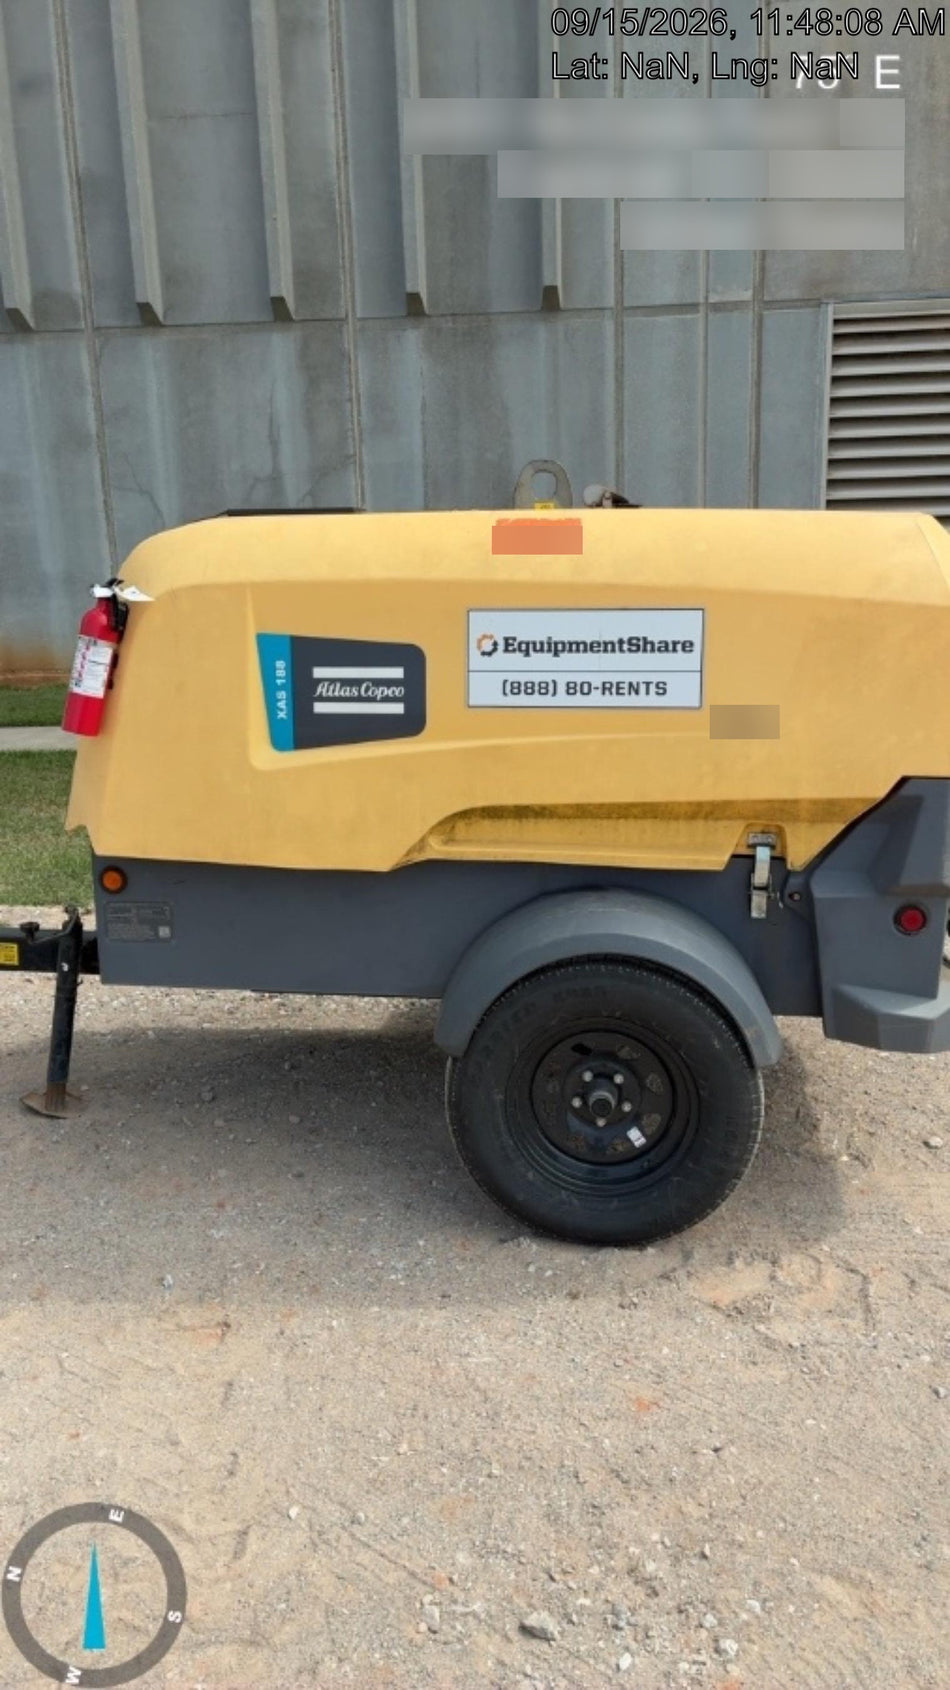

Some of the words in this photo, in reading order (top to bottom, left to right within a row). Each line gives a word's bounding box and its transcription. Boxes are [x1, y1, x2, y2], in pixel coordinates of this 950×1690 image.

[503, 636, 694, 657] EquipmentShare
[502, 679, 557, 697] (888)
[565, 680, 668, 696] 80-RENTS
[277, 690, 287, 720] XAS
